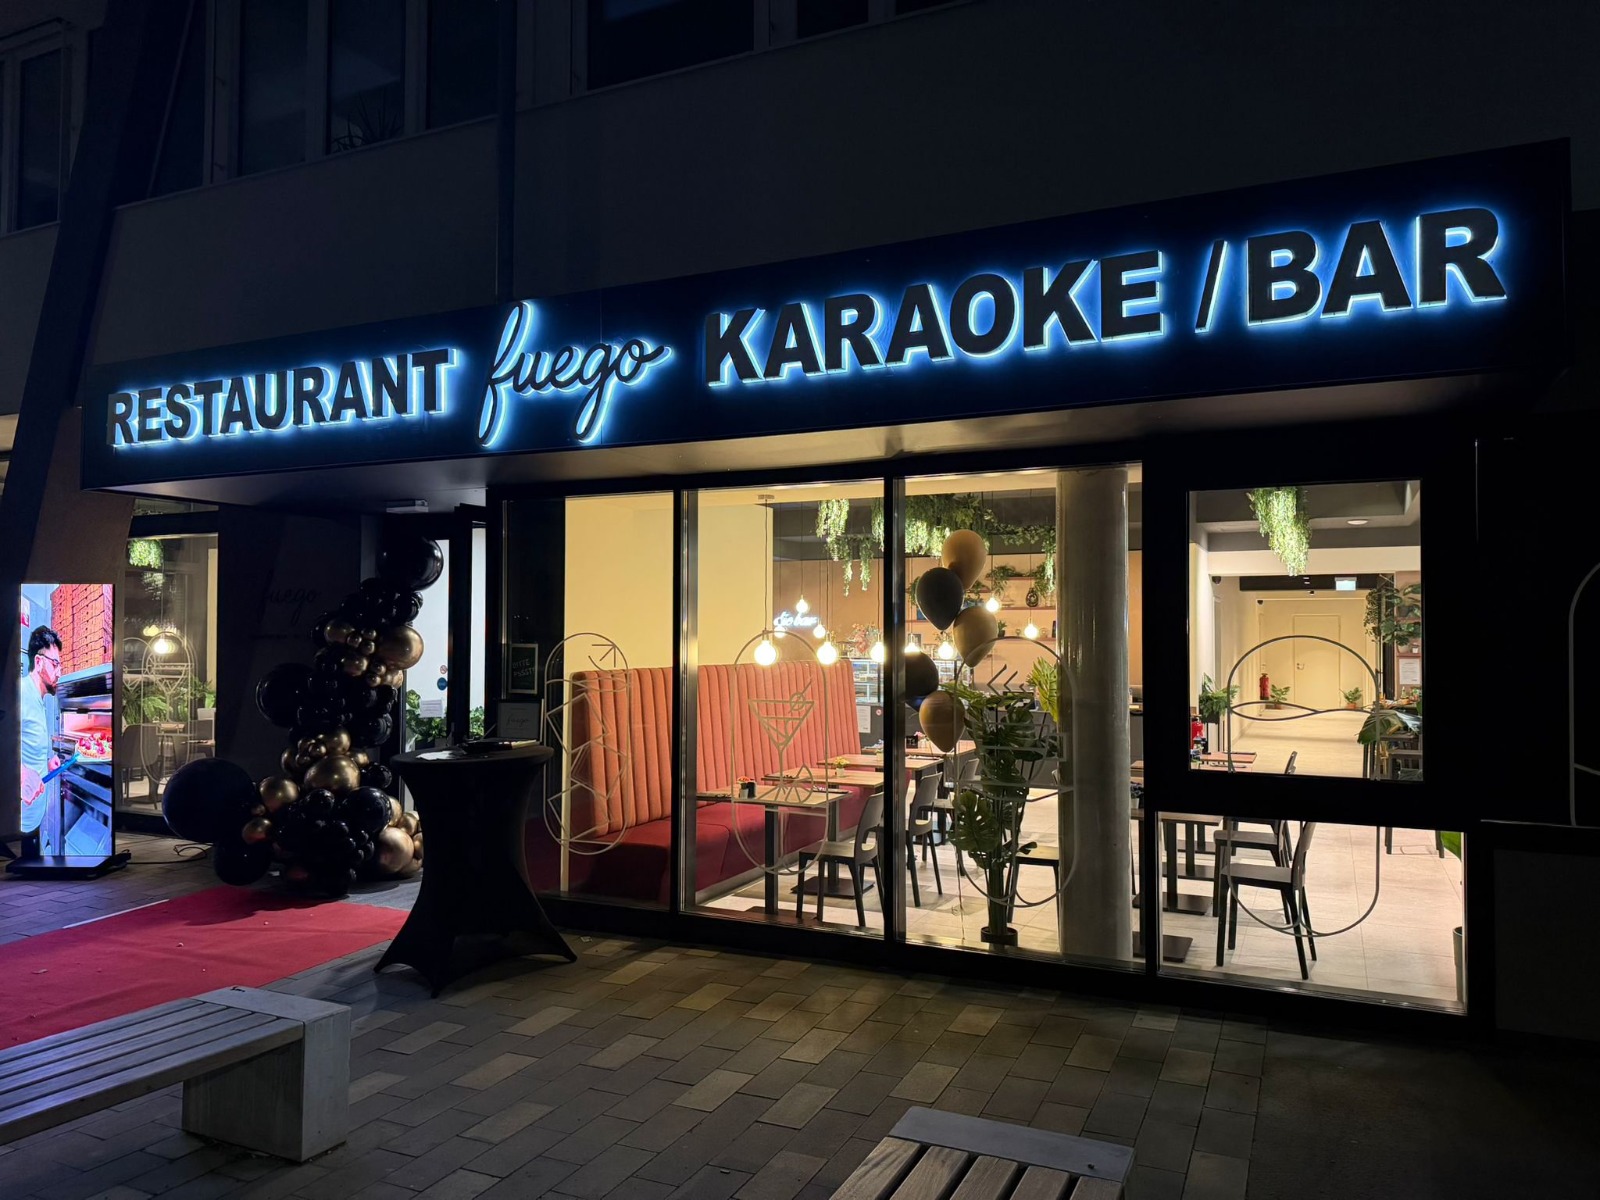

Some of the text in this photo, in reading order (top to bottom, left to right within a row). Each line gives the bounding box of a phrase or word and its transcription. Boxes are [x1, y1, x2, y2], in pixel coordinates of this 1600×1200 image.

[106, 347, 457, 449] RESTAURANT
[476, 300, 672, 447] fuego
[704, 250, 1165, 386] KARAOKE
